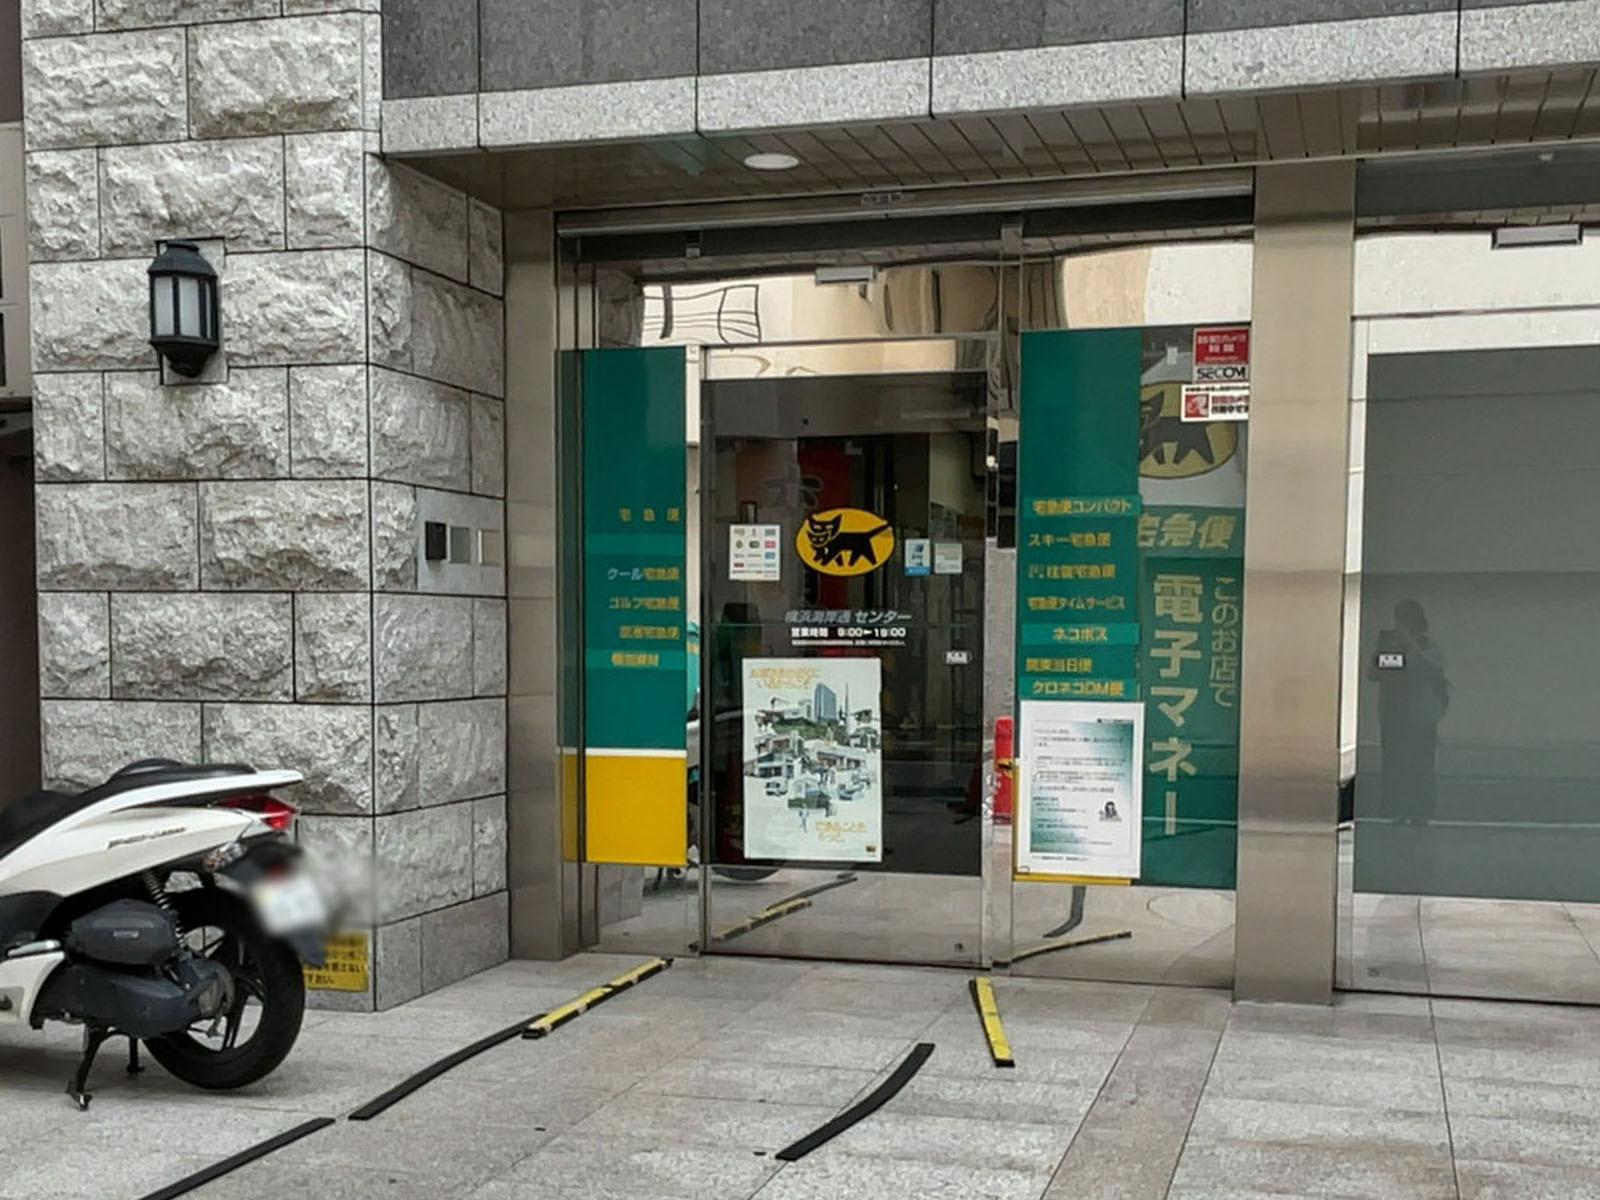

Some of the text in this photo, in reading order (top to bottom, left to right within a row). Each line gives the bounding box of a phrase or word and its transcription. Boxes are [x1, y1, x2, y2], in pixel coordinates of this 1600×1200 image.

[1196, 366, 1246, 380] SECOM
[1028, 532, 1111, 548] スキー宅急便
[607, 566, 680, 581] クール宅急便
[854, 609, 913, 624] センター
[1052, 626, 1108, 642] ネコポス
[1208, 576, 1238, 708] このお店で
[1032, 680, 1124, 696] クロネコDM便
[1149, 574, 1204, 836] 電子マネー
